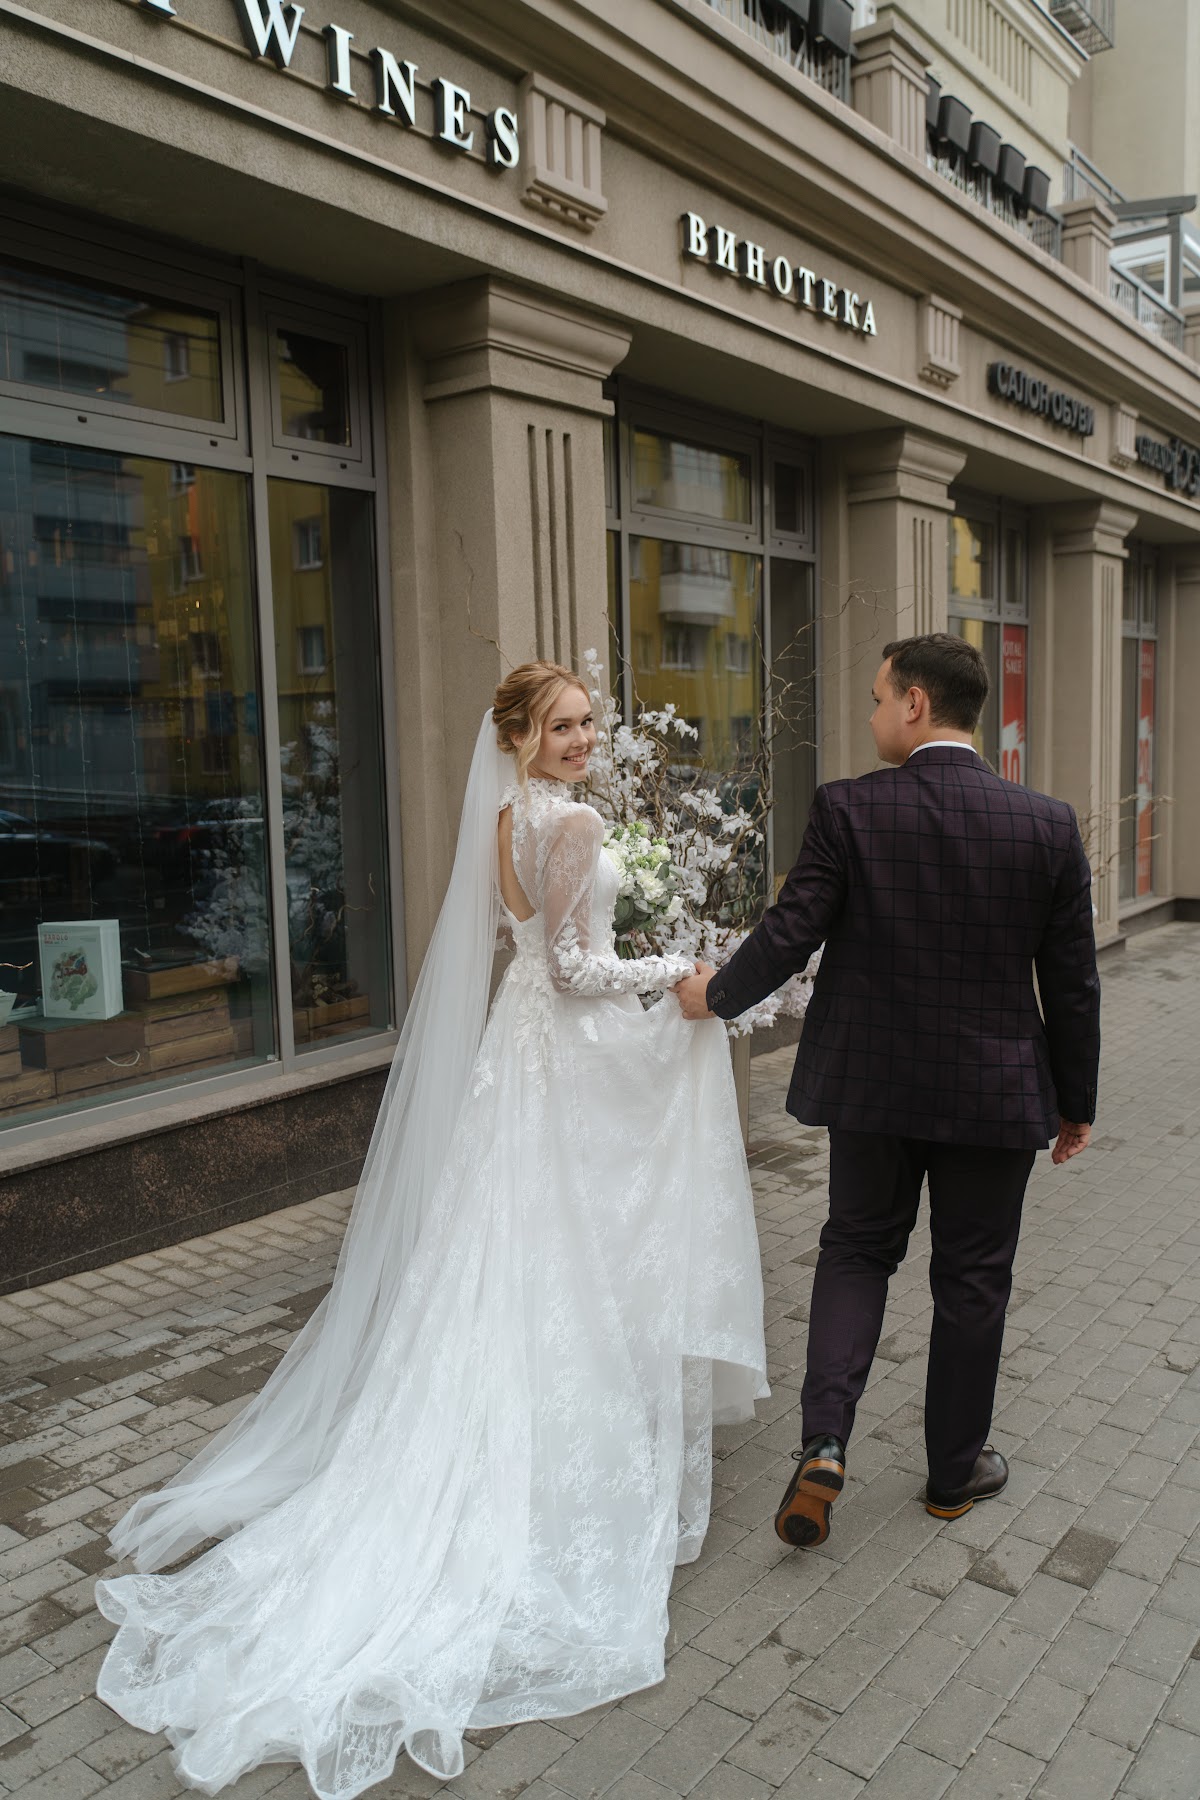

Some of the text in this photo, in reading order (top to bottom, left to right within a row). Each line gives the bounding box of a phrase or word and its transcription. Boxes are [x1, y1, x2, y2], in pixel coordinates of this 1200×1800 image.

[240, 0, 521, 170] WINES
[684, 210, 878, 337] ВИНОТЕКА
[992, 361, 1095, 434] САЛОН ОБУВИ
